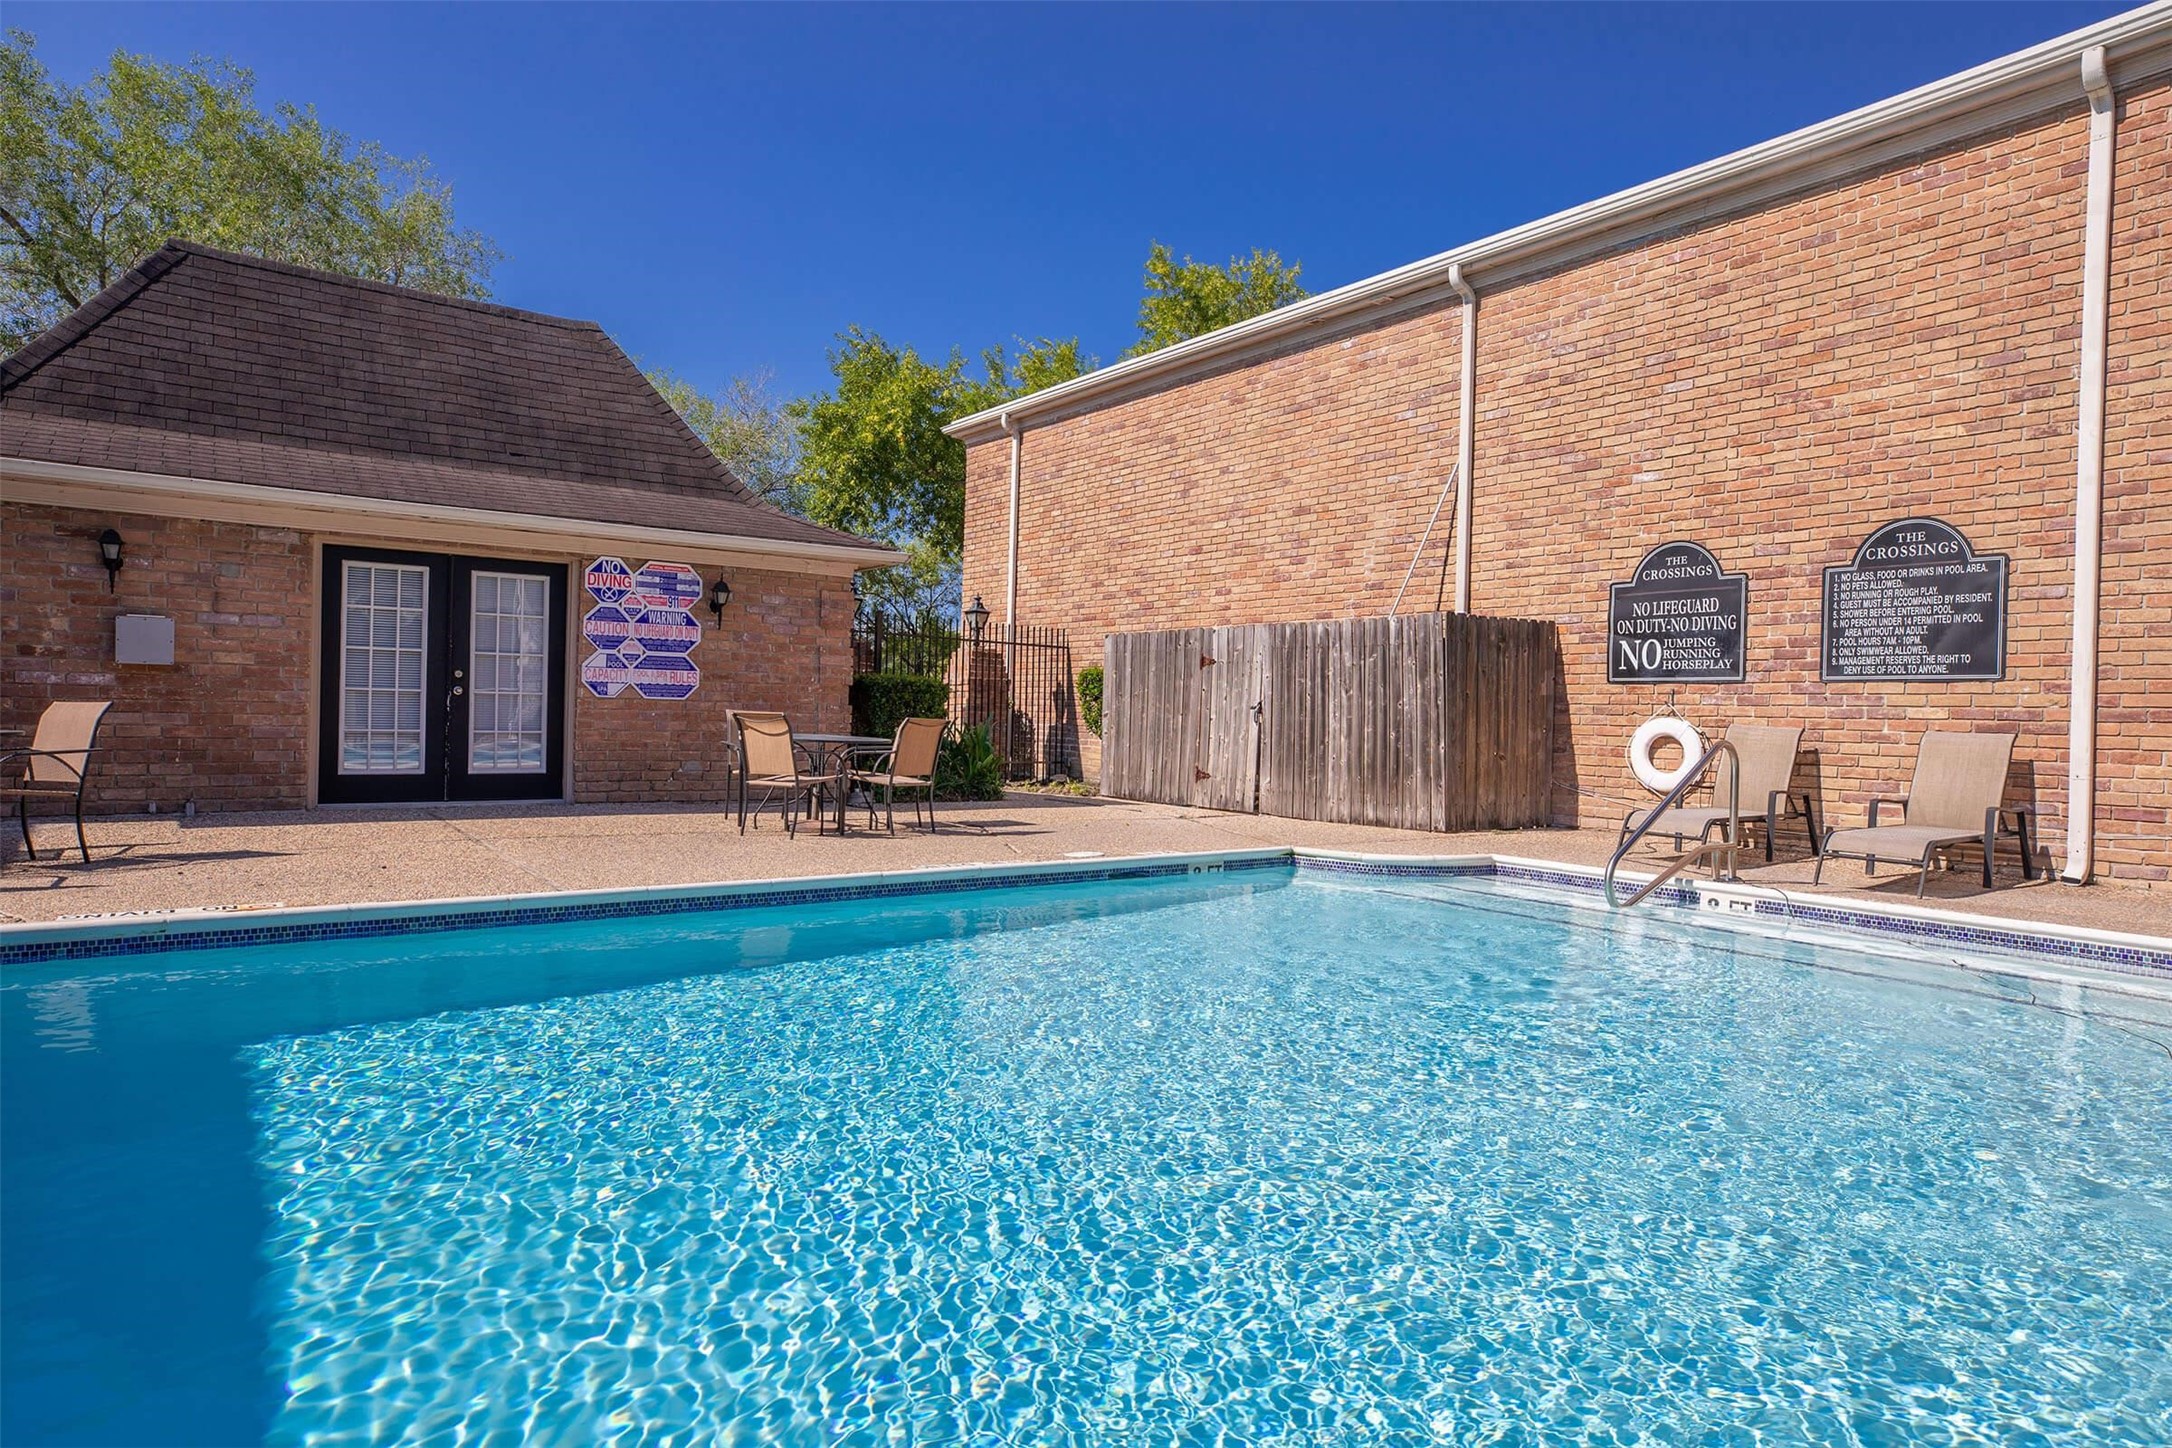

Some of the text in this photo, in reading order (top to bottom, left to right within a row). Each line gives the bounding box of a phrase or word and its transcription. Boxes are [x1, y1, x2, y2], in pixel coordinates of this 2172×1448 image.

[1896, 531, 1926, 542] THE
[1866, 541, 1958, 560] CROSSINGS
[602, 561, 620, 574] NO
[1666, 556, 1688, 566] THE
[1642, 565, 1713, 581] CROSSINGS
[1841, 573, 1851, 581] NO
[1853, 572, 1875, 580] GLASS,
[1877, 570, 1895, 578] FOOD
[1898, 570, 1906, 578] OR
[1909, 567, 1934, 577] DRINKS
[1936, 567, 1943, 575] IN
[1945, 565, 1964, 574] POOL
[1966, 563, 1988, 572] AREA.
[587, 573, 632, 588] DIVING
[1852, 582, 1868, 590] PETS
[1870, 580, 1903, 589] ALLOWED.
[1852, 589, 1881, 599] RUNNING
[1894, 588, 1919, 596] ROUGH
[1920, 586, 1938, 595] PLAY.
[667, 596, 679, 608] 911
[1632, 597, 1719, 617] NO LIFEGUARD
[1840, 600, 1861, 609] GUEST
[1863, 599, 1882, 607] MUST
[1883, 598, 1891, 606] BE
[1893, 595, 1942, 606] ACCOMPANIED
[1945, 595, 1954, 603] BY
[1956, 593, 1992, 602] RESIDENT.
[648, 611, 687, 625] WARNING
[1840, 609, 1868, 618] SHOWER
[1869, 608, 1896, 616] BEFORE
[1898, 606, 1931, 615] ENTERING
[1617, 614, 1737, 634] ON DUTY-NO DIVING
[1840, 619, 1849, 627] NO
[1851, 618, 1878, 627] PERSON
[1879, 617, 1902, 625] UNDER
[1904, 616, 1911, 624] 14
[1913, 615, 1951, 624] PERMITTED
[1953, 614, 1960, 622] IN
[1963, 613, 1983, 622] POOL
[585, 621, 629, 635] CAUTION
[634, 624, 699, 639] NO LIFEGUARD ON DUTY
[1845, 628, 1862, 636] AREA
[1863, 627, 1892, 636] WITHOUT
[1906, 626, 1928, 634] ADULT.
[1833, 638, 1837, 646] 7.
[1839, 638, 1856, 646] POOL
[1858, 637, 1881, 645] HOURS
[1883, 636, 1896, 644] 7AM
[1903, 635, 1921, 644] 10PM.
[1618, 637, 1716, 670] NO JUMPING
[1663, 648, 1721, 659] RUNNING
[1839, 647, 1855, 656] ONLY
[1857, 646, 1893, 655] SWIMWEAR
[1894, 645, 1929, 654] ALLOWED.
[1662, 659, 1733, 670] HORSEPLAY
[1839, 656, 1884, 665] MANAGEMENT
[1885, 655, 1920, 664] RESERVES
[1922, 655, 1936, 663] THE
[1937, 654, 1959, 663] RIGHT
[1961, 654, 1971, 663] TO
[584, 669, 629, 681] CAPACITY
[1844, 666, 1861, 674] DENY
[1863, 666, 1875, 674] USE
[1888, 665, 1906, 674] POOL
[1908, 665, 1917, 673] TO
[1918, 664, 1948, 673] ANYONE.
[670, 671, 698, 684] RULES
